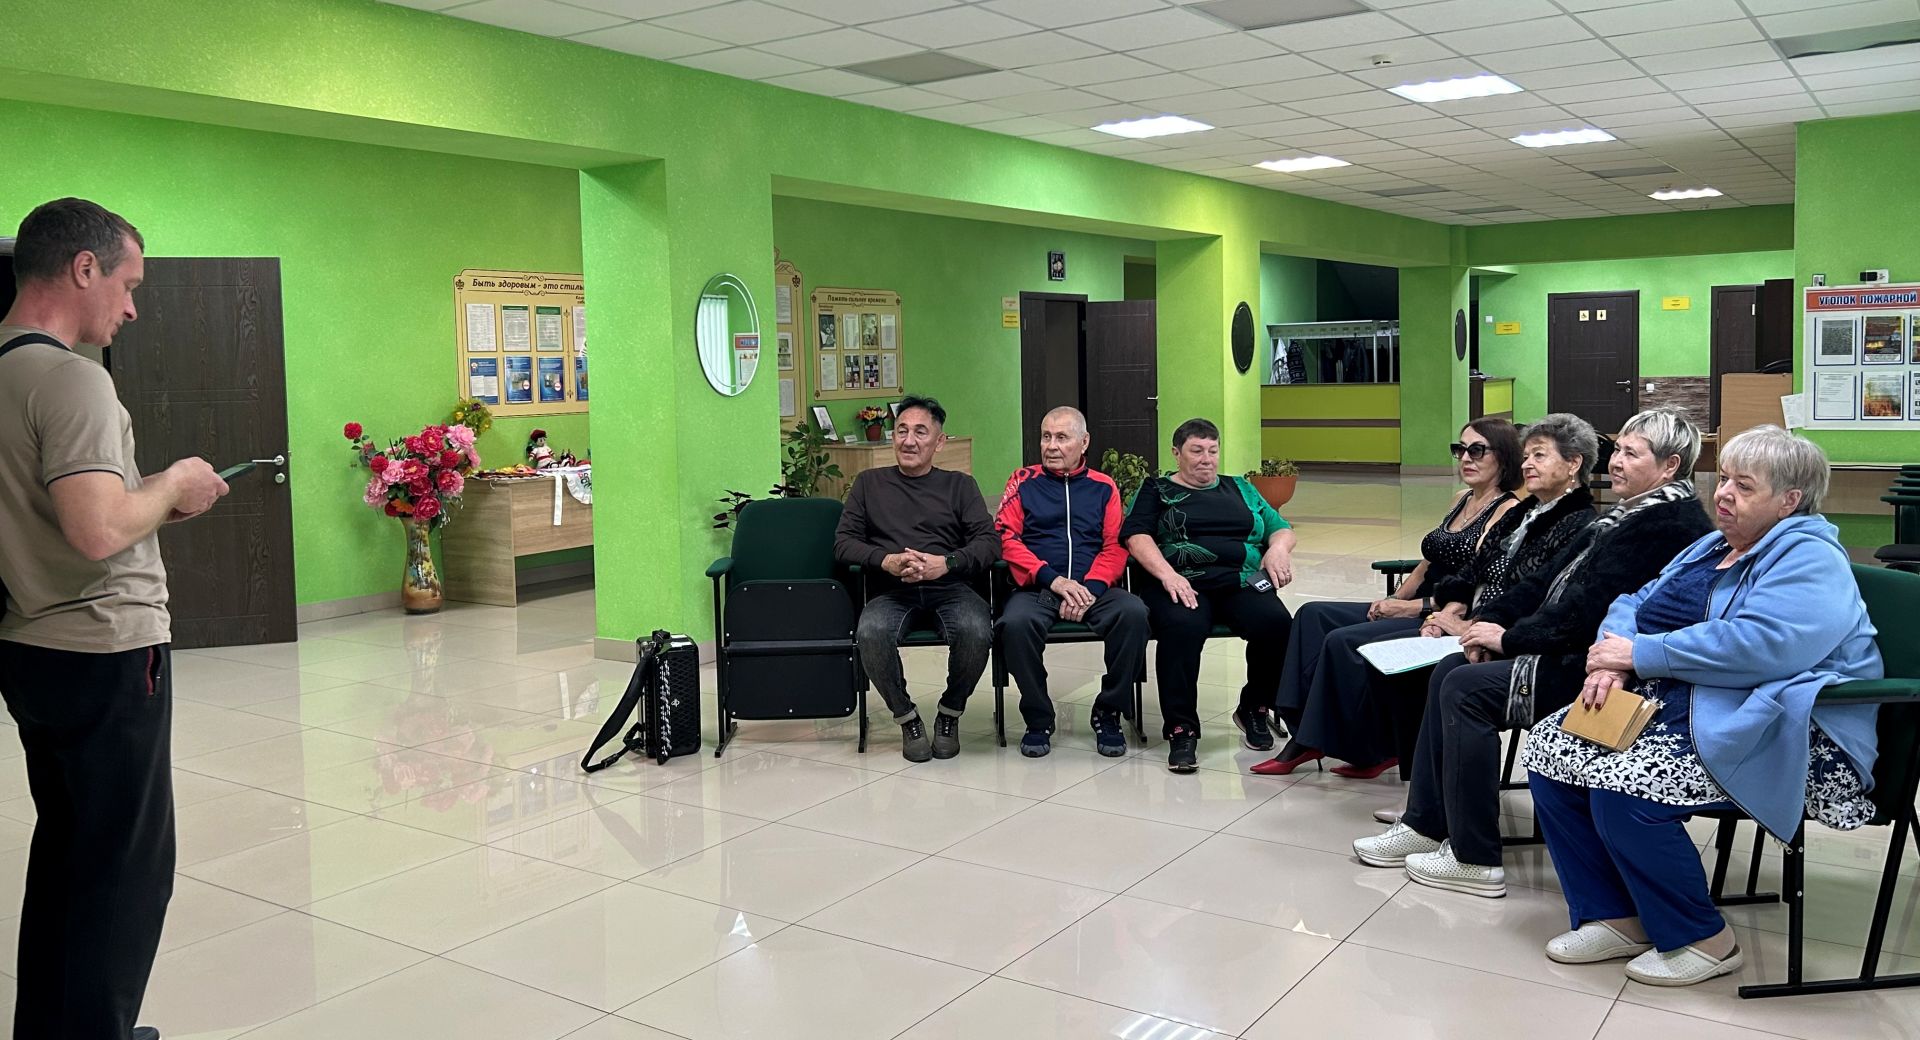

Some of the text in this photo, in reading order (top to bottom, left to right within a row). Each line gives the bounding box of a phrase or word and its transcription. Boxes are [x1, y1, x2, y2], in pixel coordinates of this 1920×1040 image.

[472, 278, 496, 288] Быть
[498, 279, 536, 290] здоровым
[1819, 291, 1917, 306] УГОЛОК ПОЖАРНОЙ
